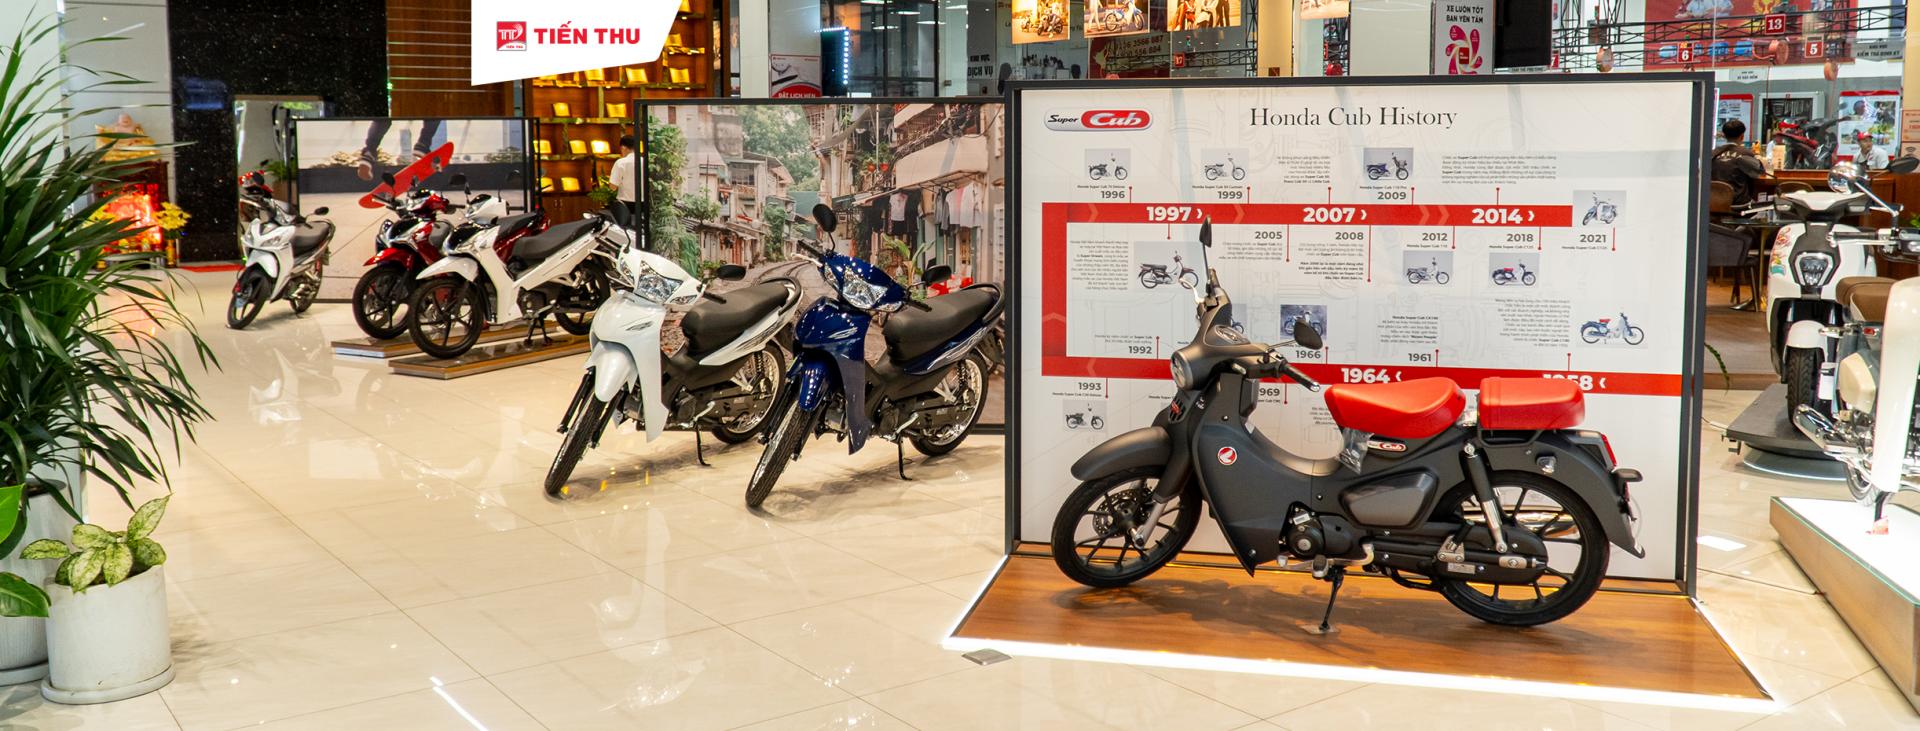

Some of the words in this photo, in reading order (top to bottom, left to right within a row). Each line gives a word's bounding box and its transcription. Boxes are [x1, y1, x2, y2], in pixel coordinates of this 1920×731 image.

[1447, 5, 1455, 13] XE
[1455, 5, 1471, 13] LUÔN
[1472, 5, 1484, 14] TỐT
[1459, 15, 1470, 23] YÊN
[1472, 16, 1484, 24] TÂM
[1768, 18, 1782, 30] 13
[1810, 43, 1818, 55] 5
[1681, 50, 1689, 61] 6
[968, 66, 983, 78] DỊCH
[984, 65, 994, 78] VỤ
[1048, 114, 1079, 124] Super
[1089, 112, 1142, 126] Cub
[1250, 107, 1321, 126] Honda
[1328, 107, 1371, 126] Cub
[1380, 107, 1458, 129] History
[1101, 190, 1126, 199] 1996
[1217, 191, 1243, 199] 1999
[1377, 191, 1406, 200] 2009
[1146, 206, 1192, 221] 1997
[1303, 207, 1356, 223] 2007
[1472, 208, 1524, 224] 2014
[1254, 231, 1282, 240] 2005
[1335, 232, 1364, 240] 2008
[1422, 232, 1448, 241] 2012
[1506, 233, 1534, 242] 2018
[1580, 234, 1606, 243] 2021
[1128, 346, 1152, 354] 1992
[1296, 350, 1321, 359] 1966
[1408, 353, 1431, 362] 1961
[1341, 367, 1391, 384] 1964
[1078, 382, 1102, 390] 1993
[1260, 388, 1280, 396] 969
